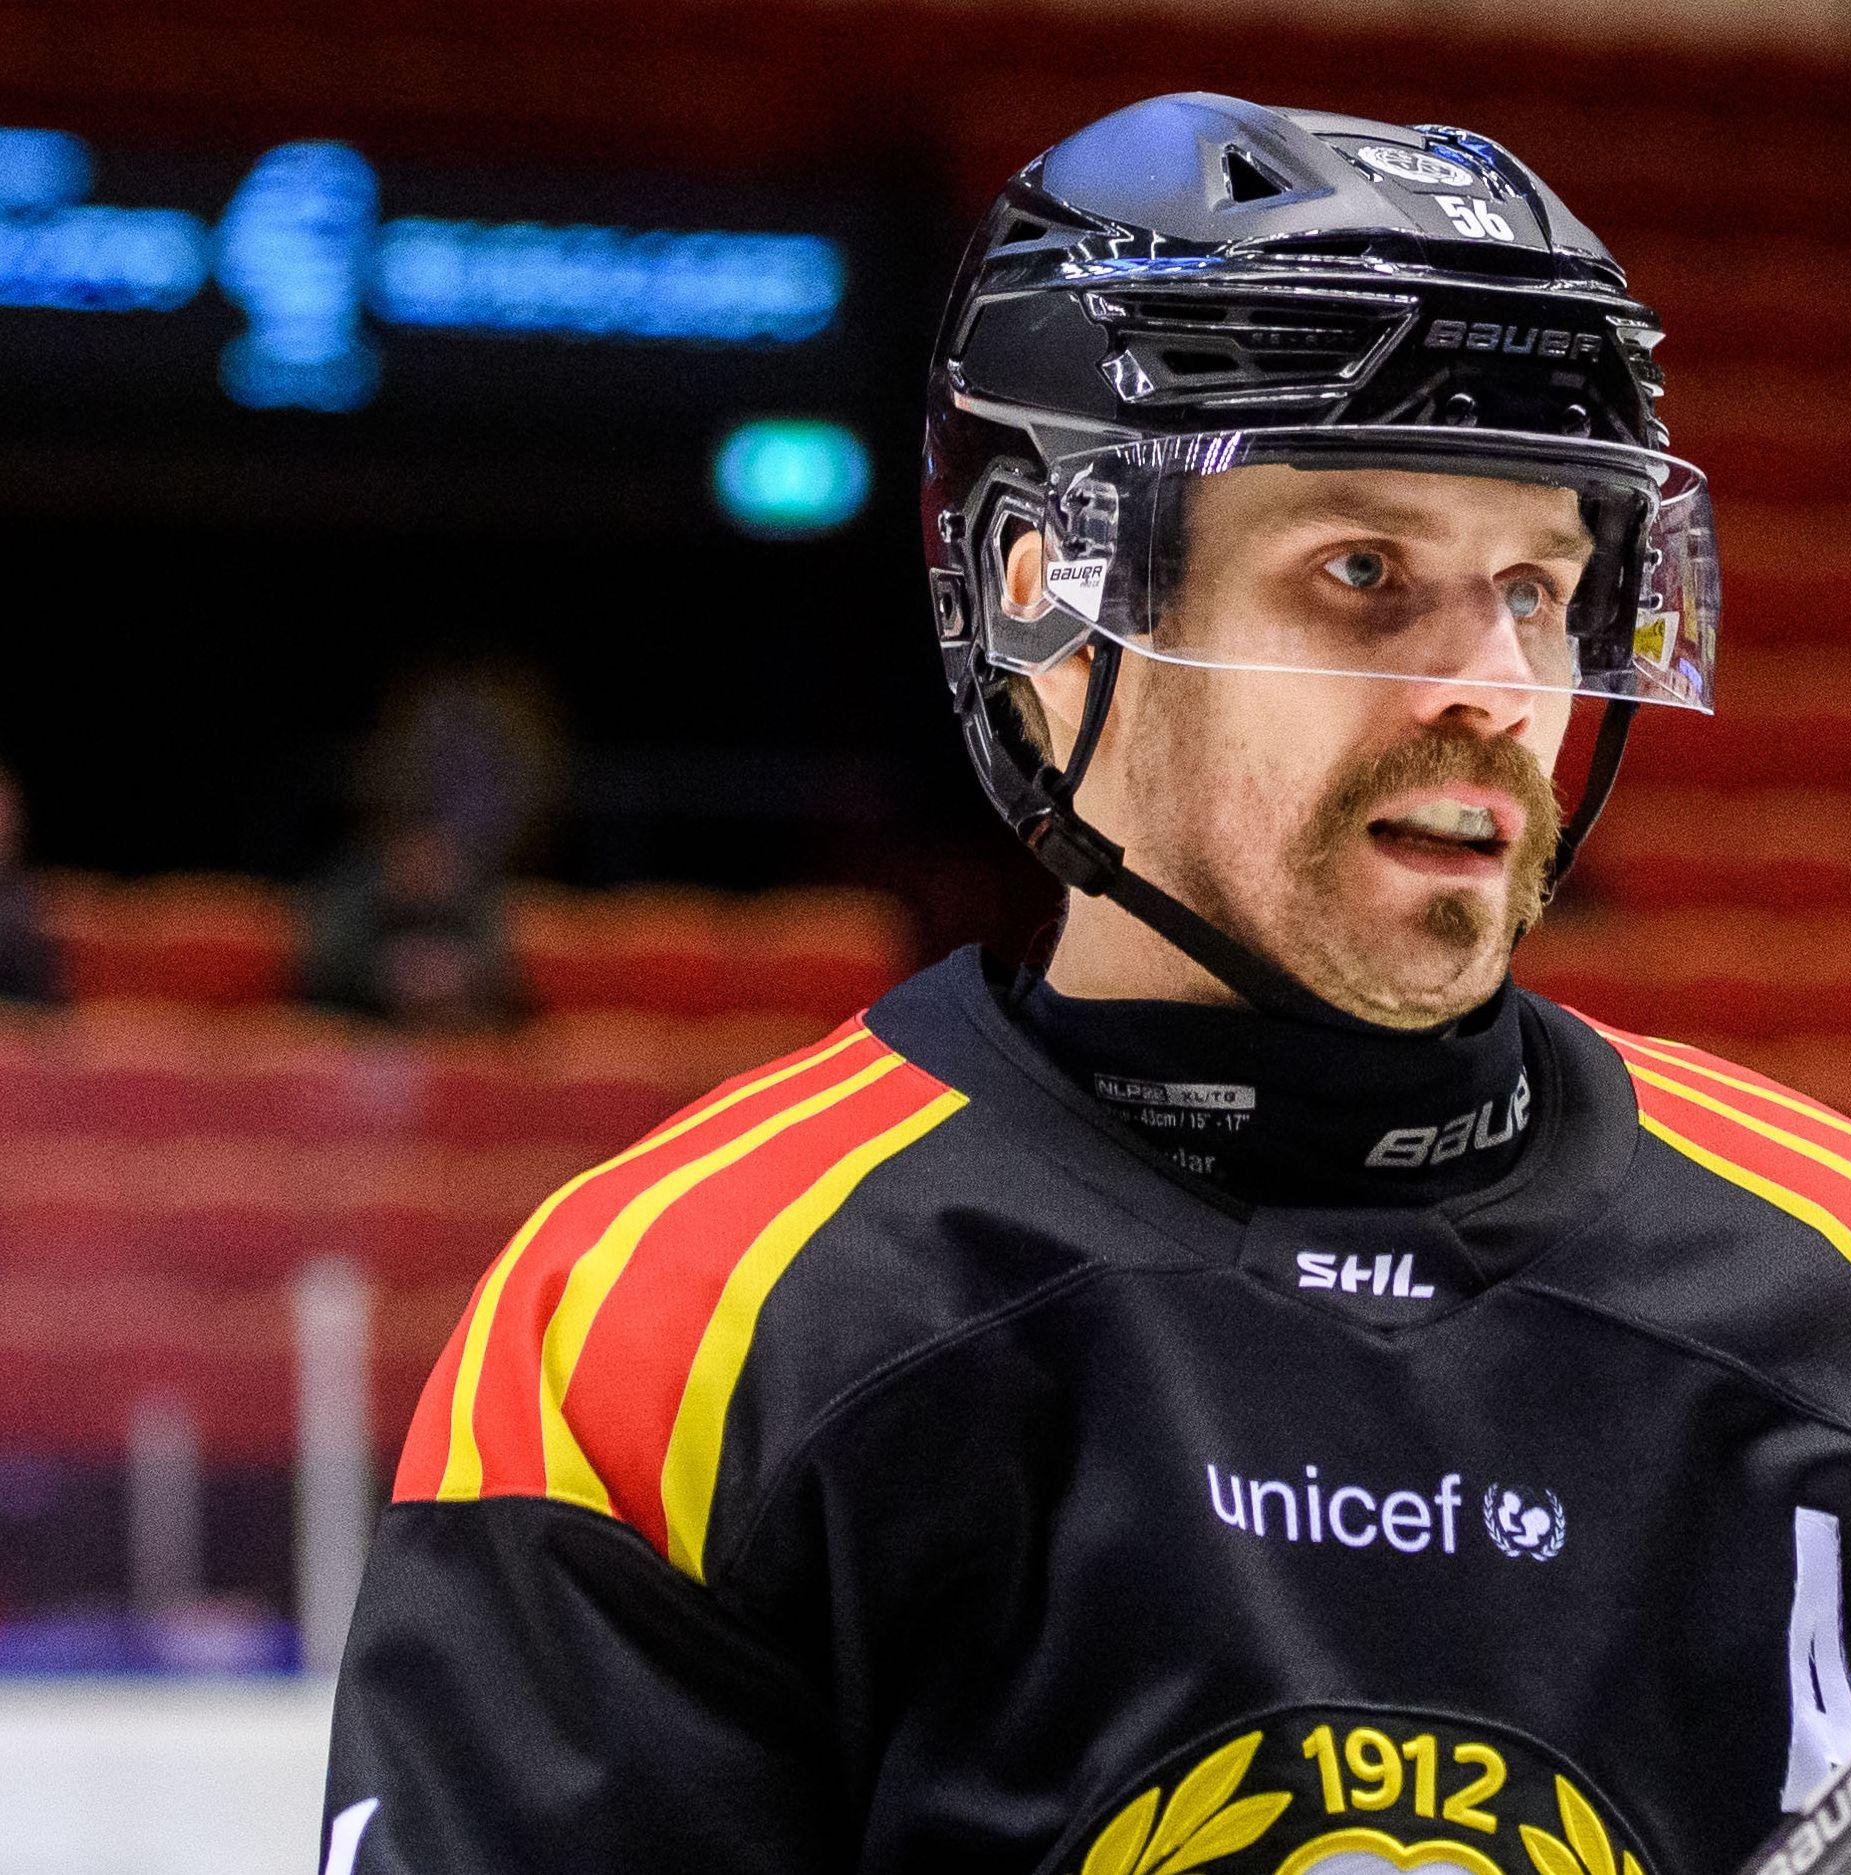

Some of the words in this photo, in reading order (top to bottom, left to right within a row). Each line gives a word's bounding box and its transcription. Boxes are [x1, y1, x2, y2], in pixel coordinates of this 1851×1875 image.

[1434, 194, 1515, 242] 56
[1424, 319, 1602, 361] BAUER
[1050, 565, 1103, 581] BAUER
[1364, 1065, 1531, 1168] BAUE
[1172, 1147, 1216, 1175] lar
[1296, 1251, 1435, 1299] SHL
[1206, 1463, 1462, 1554] unicef
[1302, 1724, 1507, 1835] 1912
